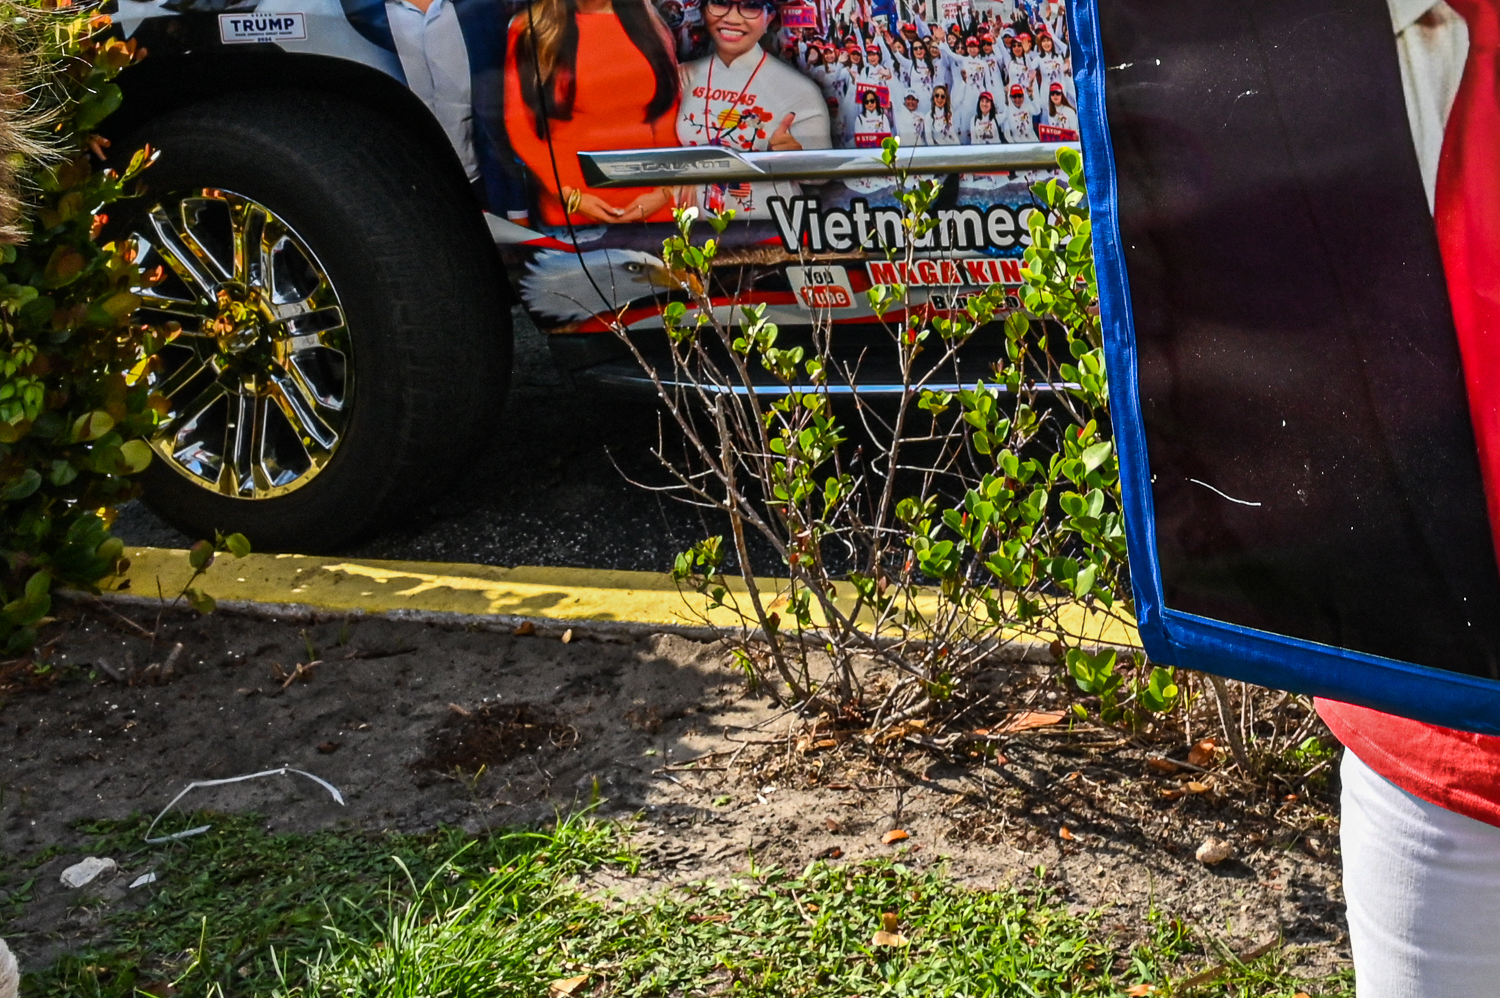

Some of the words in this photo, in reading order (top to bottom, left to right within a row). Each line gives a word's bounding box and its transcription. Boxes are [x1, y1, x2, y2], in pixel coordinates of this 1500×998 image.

[230, 18, 295, 32] TRUMP
[692, 87, 705, 99] 45
[705, 89, 740, 103] LOVE
[768, 198, 1073, 251] Vietnames
[803, 267, 835, 284] You
[868, 260, 963, 285] MAGA
[964, 259, 1029, 285] KIN
[804, 288, 847, 305] Tube
